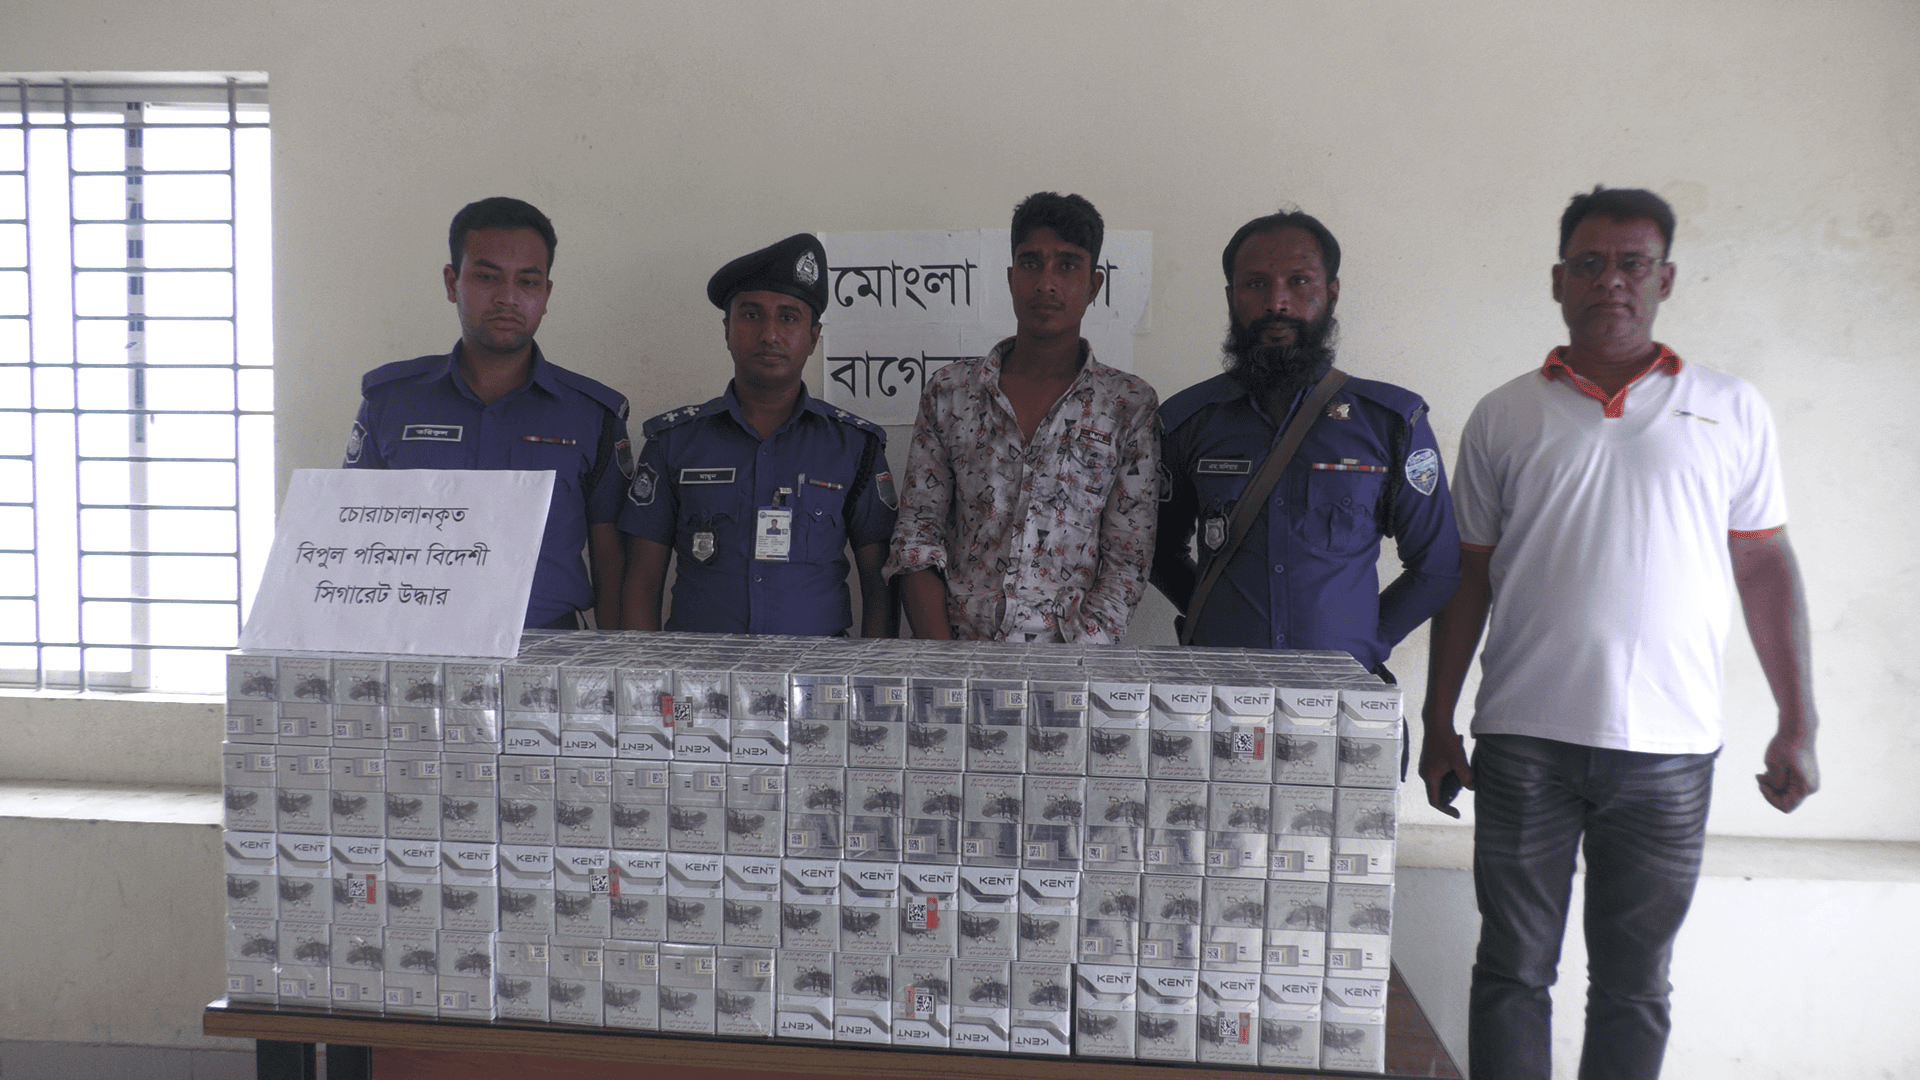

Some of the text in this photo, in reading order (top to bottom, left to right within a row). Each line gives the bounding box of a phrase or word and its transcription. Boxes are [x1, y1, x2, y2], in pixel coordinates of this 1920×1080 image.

[828, 258, 978, 311] মোংলা
[339, 505, 469, 531] চোরাচালানকৃত
[295, 541, 491, 569] বিপুল পরিমান বিদেশী
[313, 579, 451, 606] সিগারেট উদ্ধার
[1109, 691, 1145, 701] KENT
[1171, 693, 1208, 703] KENT
[1233, 695, 1270, 705] KENT
[1296, 697, 1334, 707] KENT
[1360, 700, 1398, 710] KENT
[507, 738, 541, 747] KENT
[563, 740, 597, 749] KENT
[620, 742, 654, 752] KENT
[677, 744, 711, 754] KENT
[734, 747, 768, 756] KENT
[239, 840, 271, 849] KENT
[293, 843, 325, 852] KENT
[348, 845, 380, 855] KENT
[402, 848, 435, 858] KENT
[458, 851, 490, 861] KENT
[516, 854, 549, 863] KENT
[571, 856, 605, 866] KENT
[628, 859, 661, 869] KENT
[685, 862, 719, 872] KENT
[742, 865, 776, 875] KENT
[801, 868, 835, 878] KENT
[859, 871, 894, 881] KENT
[919, 873, 954, 884] KENT
[979, 876, 1014, 886] KENT
[1039, 879, 1075, 888] KENT
[1096, 974, 1132, 984] KENT
[1158, 977, 1193, 987] KENT
[1219, 980, 1256, 991] KENT
[1281, 984, 1318, 994] KENT
[1344, 987, 1381, 998] KENT
[780, 1021, 814, 1031] KENT
[837, 1025, 872, 1035] KENT
[896, 1029, 930, 1039] KENT
[955, 1032, 989, 1043] KENT
[1014, 1036, 1049, 1047] KENT
